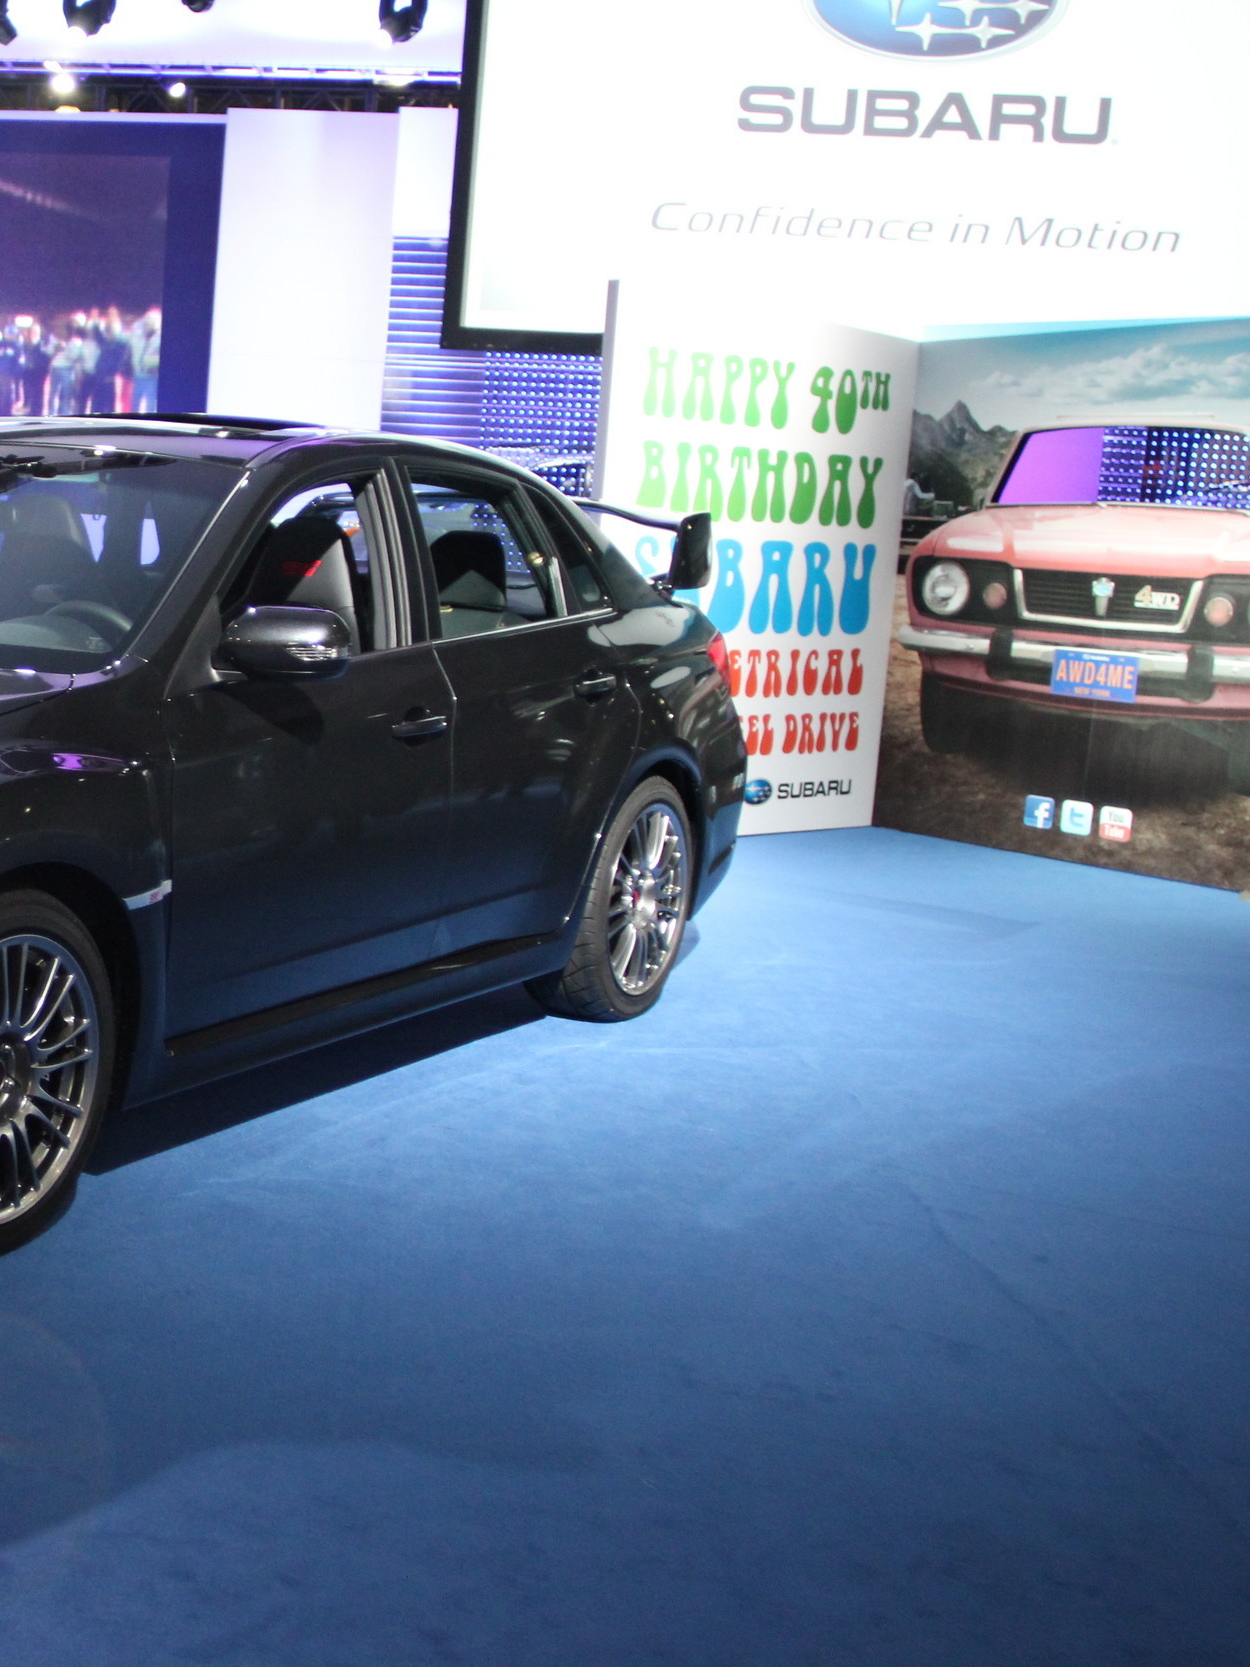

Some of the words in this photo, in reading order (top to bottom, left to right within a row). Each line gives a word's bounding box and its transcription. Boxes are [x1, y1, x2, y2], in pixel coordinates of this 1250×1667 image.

[738, 85, 1112, 145] SUBARU
[651, 202, 934, 243] Confidence
[950, 214, 991, 245] in
[1005, 215, 1180, 253] Motion
[643, 346, 796, 430] HAPPY
[810, 366, 891, 435] 40TH
[636, 440, 884, 529] BIRTHDAY
[1134, 584, 1180, 609] 4WD
[1055, 659, 1136, 690] AWD4ME
[782, 712, 859, 754] DRIVE
[777, 779, 853, 799] SUBARU
